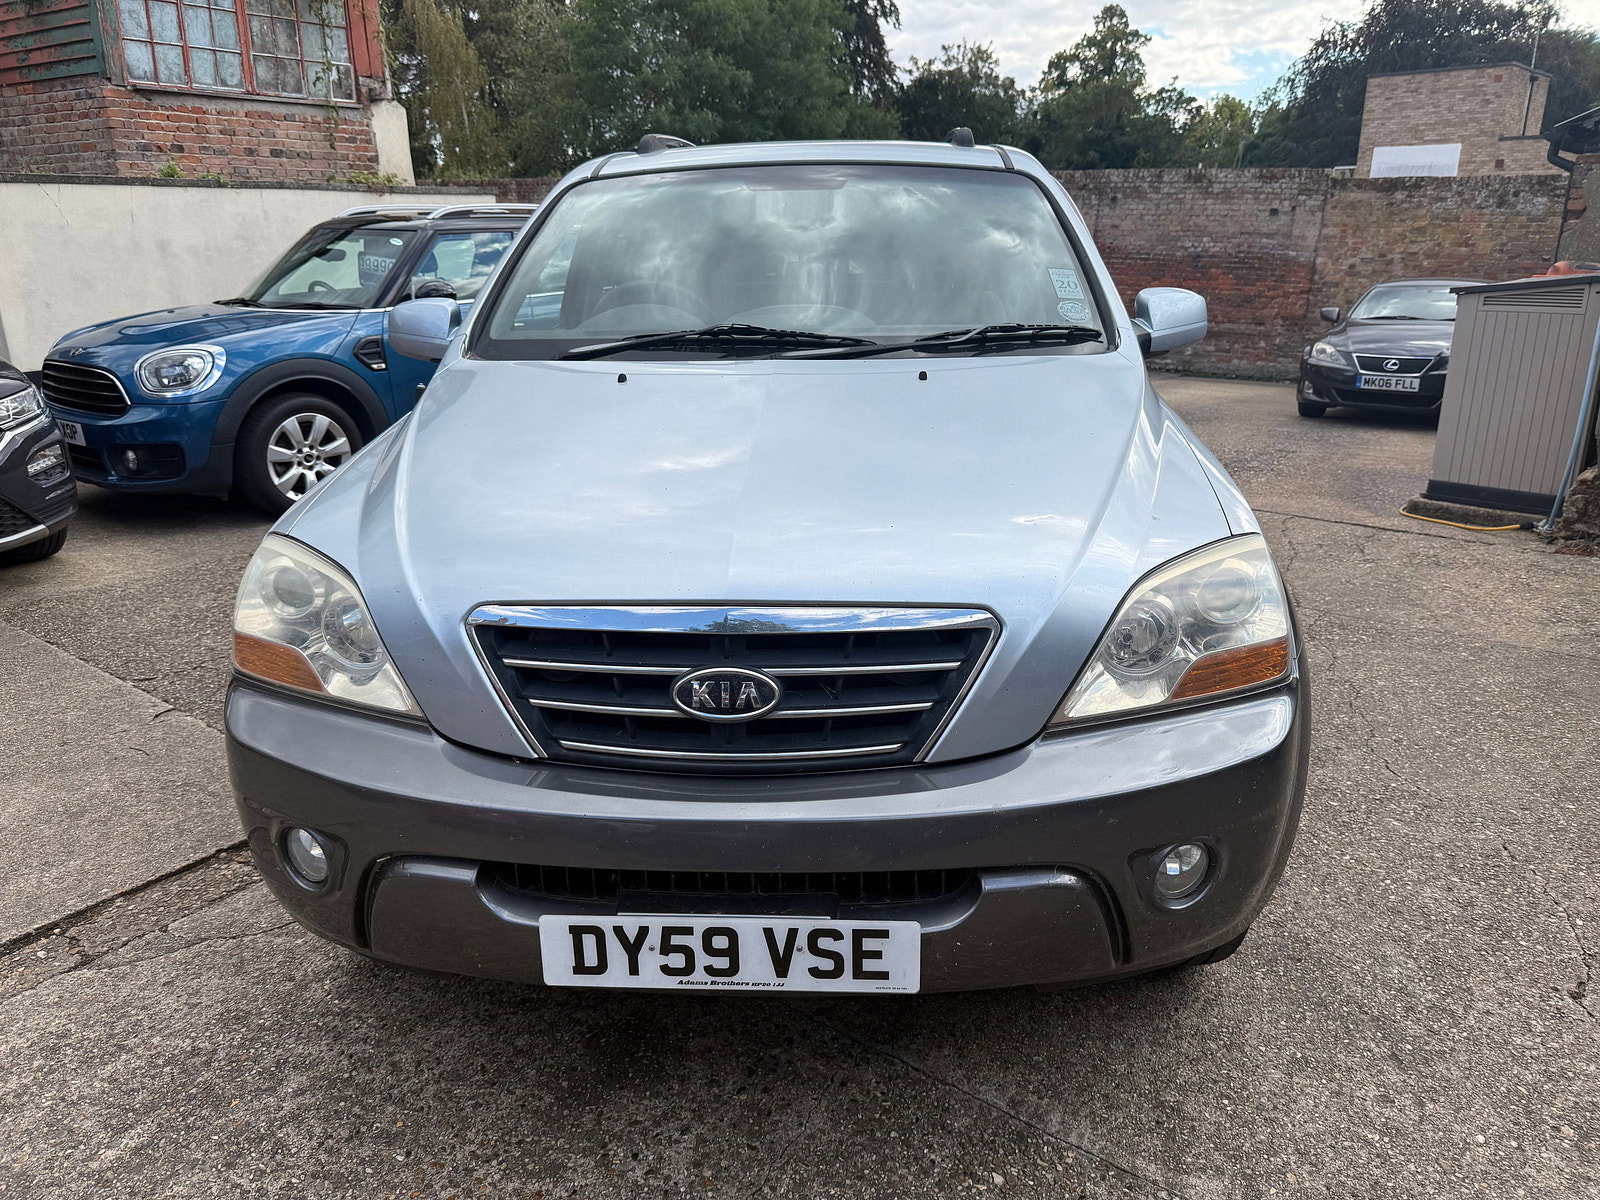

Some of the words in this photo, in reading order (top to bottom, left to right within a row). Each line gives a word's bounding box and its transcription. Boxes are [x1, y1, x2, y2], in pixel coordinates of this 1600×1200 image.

[1055, 279, 1078, 290] 20
[1363, 377, 1392, 388] MK06
[1394, 380, 1417, 390] FLL
[690, 681, 761, 708] KIA
[568, 925, 740, 977] DY59
[762, 928, 890, 980] VSE
